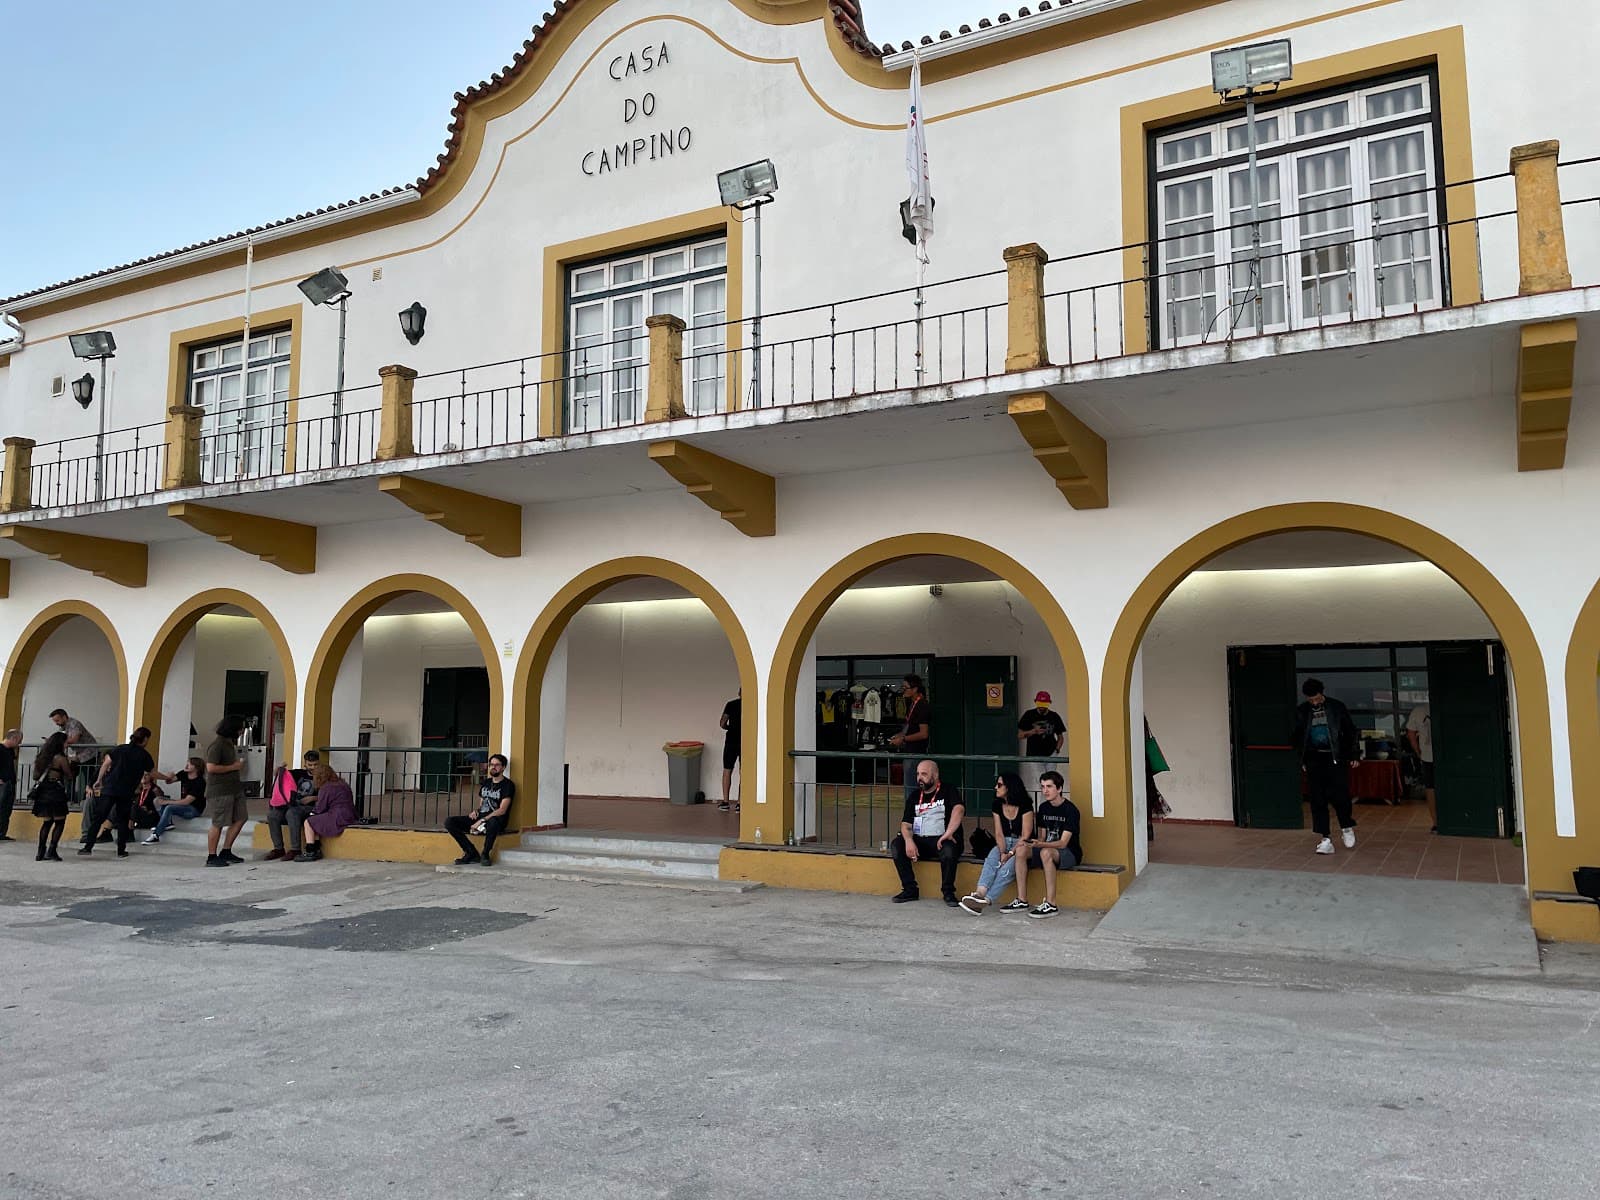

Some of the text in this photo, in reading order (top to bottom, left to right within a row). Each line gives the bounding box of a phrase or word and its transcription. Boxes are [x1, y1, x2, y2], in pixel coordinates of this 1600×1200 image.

[609, 41, 669, 80] CASA
[624, 92, 655, 123] DO
[581, 126, 691, 175] CAMPINO
